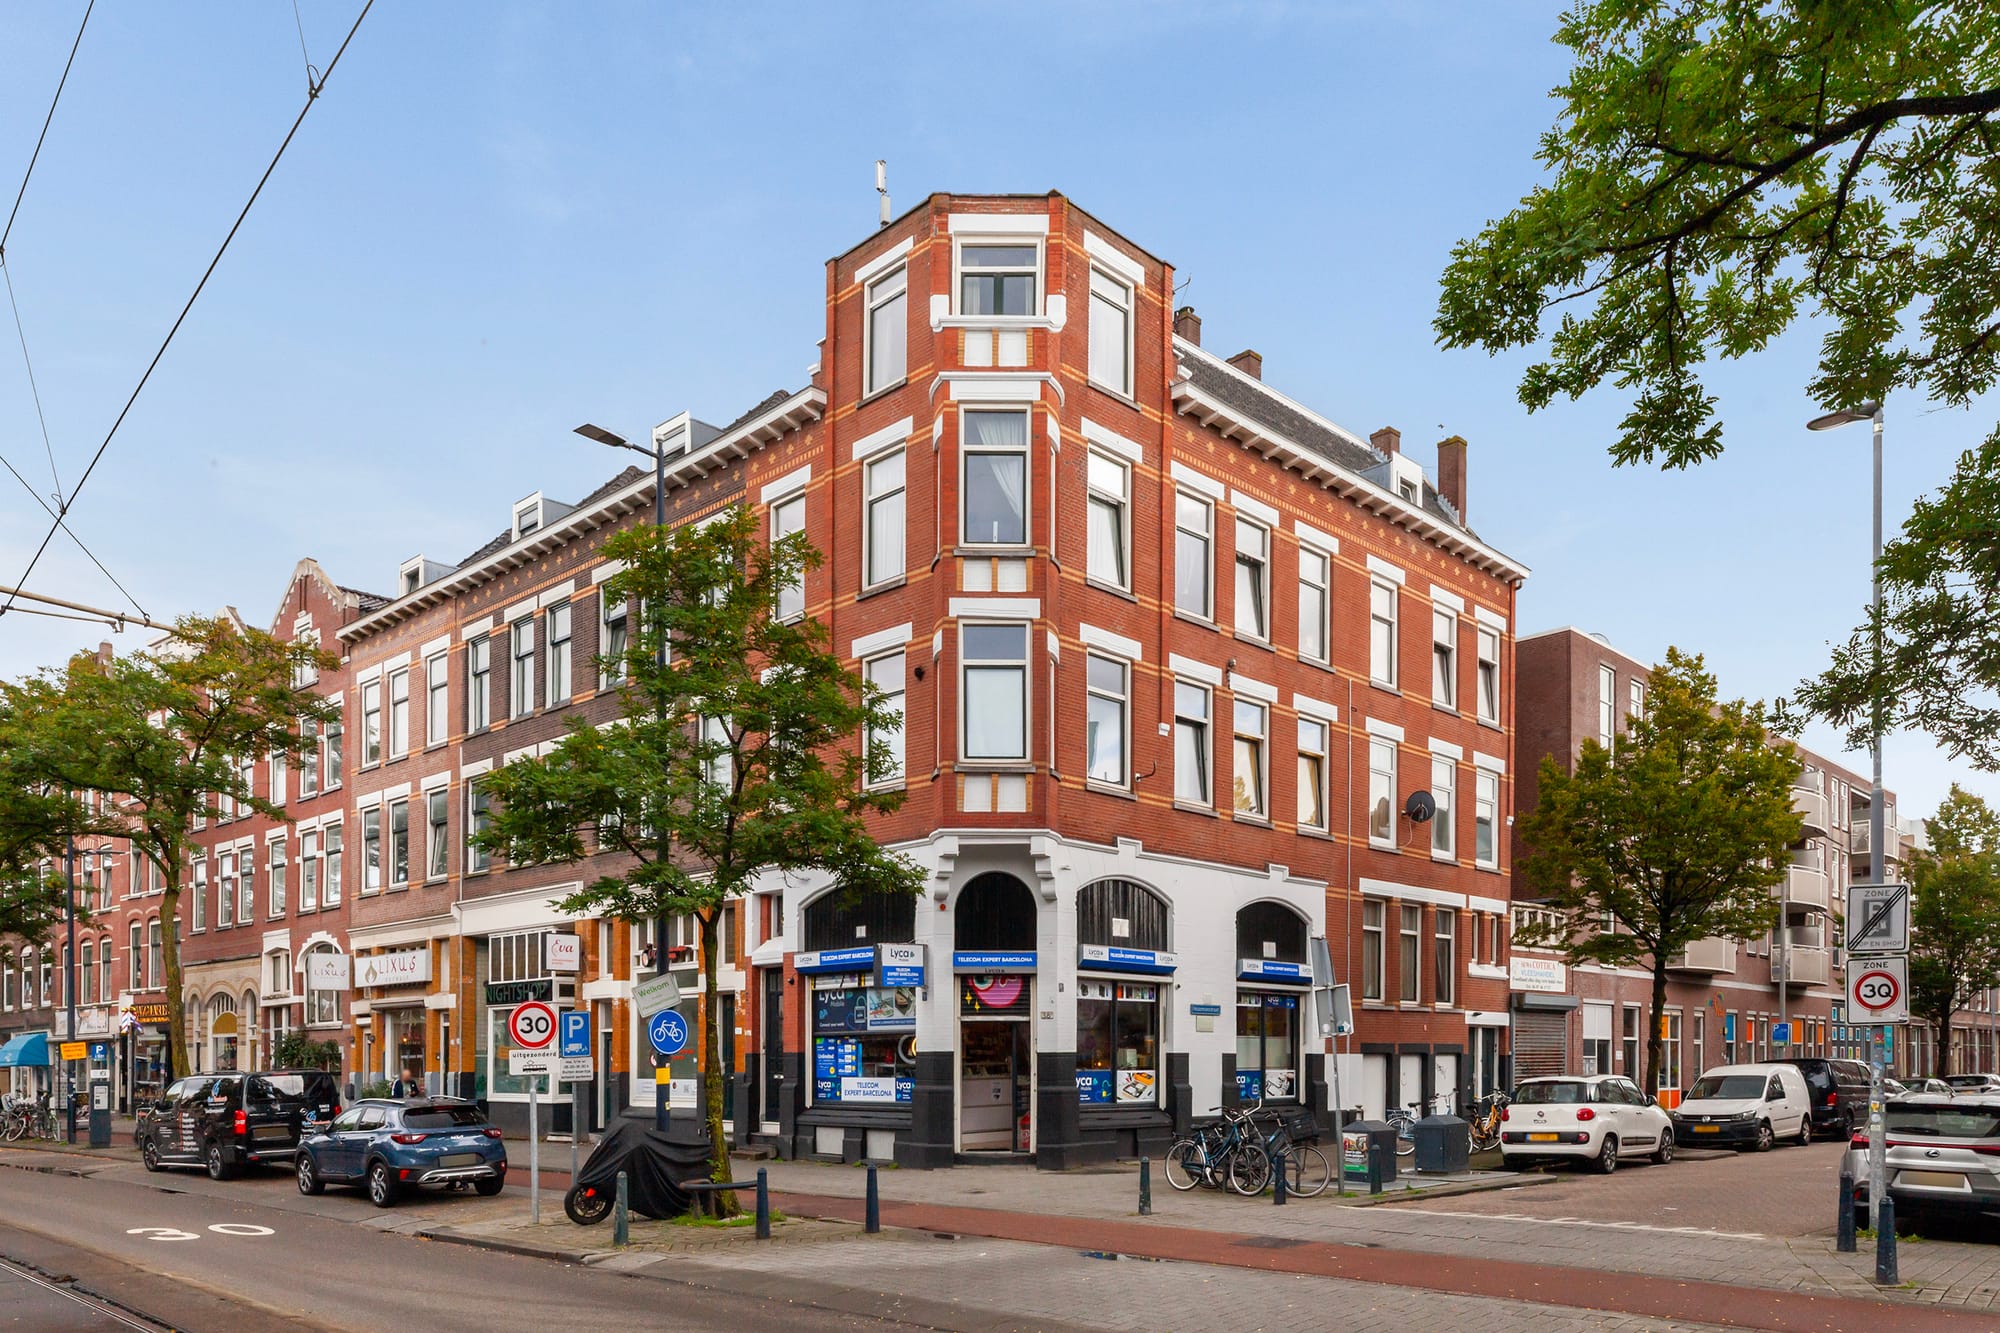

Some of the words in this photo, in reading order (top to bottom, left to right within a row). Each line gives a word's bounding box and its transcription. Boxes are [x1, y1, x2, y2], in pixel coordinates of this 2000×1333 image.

[1864, 889, 1891, 898] ZONE
[551, 938, 574, 957] Eva
[890, 947, 910, 959] Lyca
[1863, 961, 1889, 969] ZONE
[638, 981, 670, 997] Welkom
[520, 1016, 550, 1034] 30
[569, 1015, 585, 1039] P
[818, 1080, 832, 1089] Lyca
[896, 1081, 911, 1091] Lyca
[844, 1089, 862, 1097] EXPERT
[862, 1089, 892, 1097] BARCELONA
[126, 1223, 275, 1241] 30
